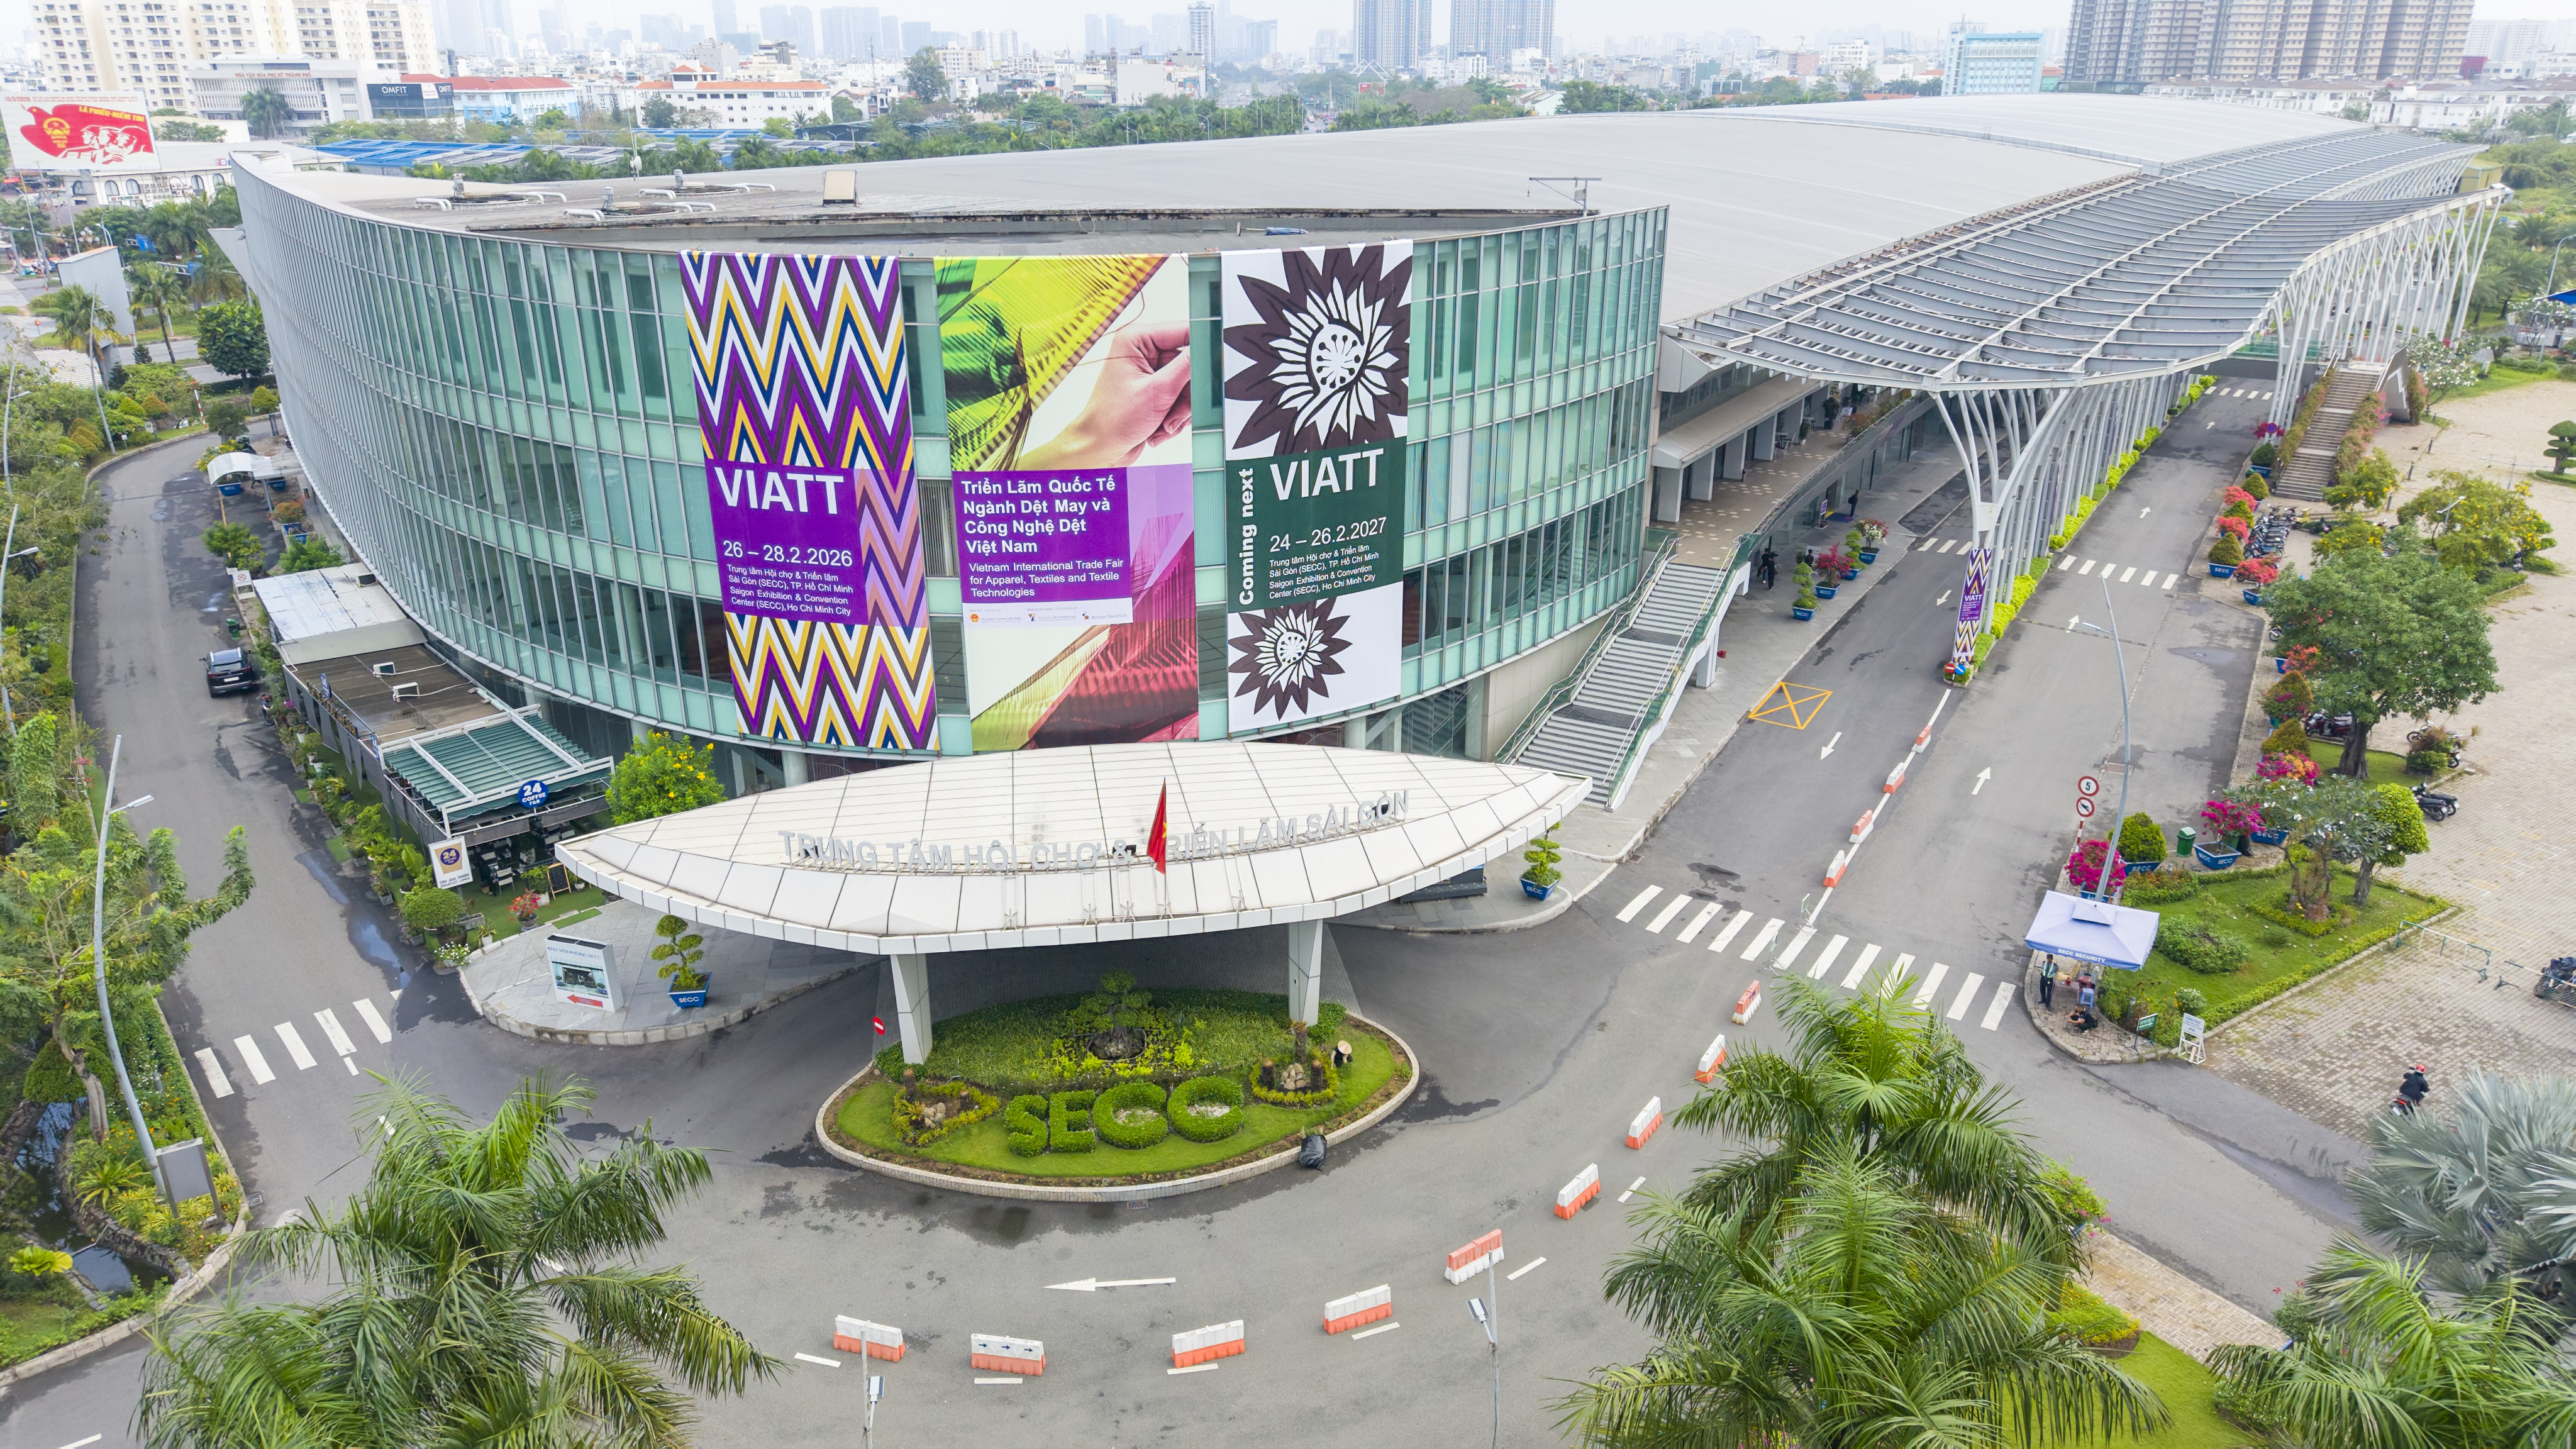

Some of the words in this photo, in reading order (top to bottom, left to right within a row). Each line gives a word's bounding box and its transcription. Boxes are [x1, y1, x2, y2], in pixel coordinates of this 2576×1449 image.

[961, 478, 1002, 494] Triển
[1007, 480, 1041, 494] Lãm
[1048, 475, 1092, 494] Quốc
[1096, 474, 1116, 491] Tế
[1269, 448, 1384, 501] VIATT
[714, 467, 844, 514] VIATT
[1238, 468, 1253, 518] next
[963, 500, 1016, 517] Ngành
[1021, 500, 1048, 516] Dệt
[1055, 499, 1087, 515] May
[1091, 497, 1111, 511] và
[964, 520, 1008, 536] Công
[1013, 519, 1055, 536] Nghệ
[1059, 518, 1087, 535] Dệt
[1270, 533, 1291, 553] 24
[1311, 516, 1387, 547] 26.2.2027
[723, 540, 743, 558] 26
[763, 545, 853, 567] 28.2.2026
[965, 540, 997, 556] Việt
[1001, 540, 1038, 553] Nam
[969, 563, 1009, 572] Vietnam
[1013, 560, 1073, 572] International
[1075, 560, 1102, 569] Trade
[1106, 558, 1124, 568] Fair
[1239, 524, 1257, 605] Coming
[1269, 559, 1290, 567] Trung
[1306, 553, 1318, 563] Hội
[1269, 569, 1281, 577] Sài
[1282, 567, 1297, 575] Gòn
[1341, 557, 1350, 565] Hồ
[1364, 552, 1379, 562] Minh
[727, 564, 747, 575] Trung
[749, 567, 763, 575] tâm
[764, 569, 777, 578] Hội
[779, 571, 793, 580] chợ
[970, 575, 982, 585] for
[985, 575, 1026, 586] Apparel,
[1029, 574, 1065, 584] Textiles
[1068, 572, 1086, 582] and
[1089, 572, 1119, 581] Textile
[1269, 579, 1294, 589] Saigon
[1296, 573, 1328, 585] Exhibition
[1337, 565, 1372, 577] Convention
[728, 575, 740, 584] Sài
[741, 577, 757, 586] Gòn
[758, 579, 789, 590] (SECC),
[790, 582, 803, 590] TP.
[805, 581, 816, 591] Hồ
[834, 585, 853, 594] Minh
[970, 587, 1035, 598] Technologies
[1269, 590, 1292, 599] Center
[1293, 584, 1321, 597] (SECC),
[1346, 577, 1362, 586] Minh
[1363, 574, 1375, 582] City
[730, 586, 754, 597] Saigon
[757, 590, 792, 601] Exhibition
[804, 594, 848, 604] Convention
[731, 597, 755, 607] Center
[756, 600, 786, 612] (SECC),
[800, 604, 813, 613] Chi
[815, 605, 833, 614] Minh
[835, 607, 851, 617] City
[523, 782, 541, 796] 24
[2085, 782, 2091, 791] 5
[522, 792, 546, 802] COFFEE
[778, 830, 877, 867] TRUNG
[886, 838, 952, 871] TÂM
[964, 840, 1018, 876] HỘI
[1113, 839, 1134, 864] &
[1143, 821, 1227, 860] RIỂN
[1239, 818, 1297, 853] LÃM
[1307, 804, 1349, 839] SÀI
[1357, 790, 1409, 825] GÒN
[2257, 831, 2279, 839] SECC
[443, 849, 457, 859] 24
[2075, 952, 2106, 963] SECURITY
[1005, 1075, 1245, 1158] SECC
